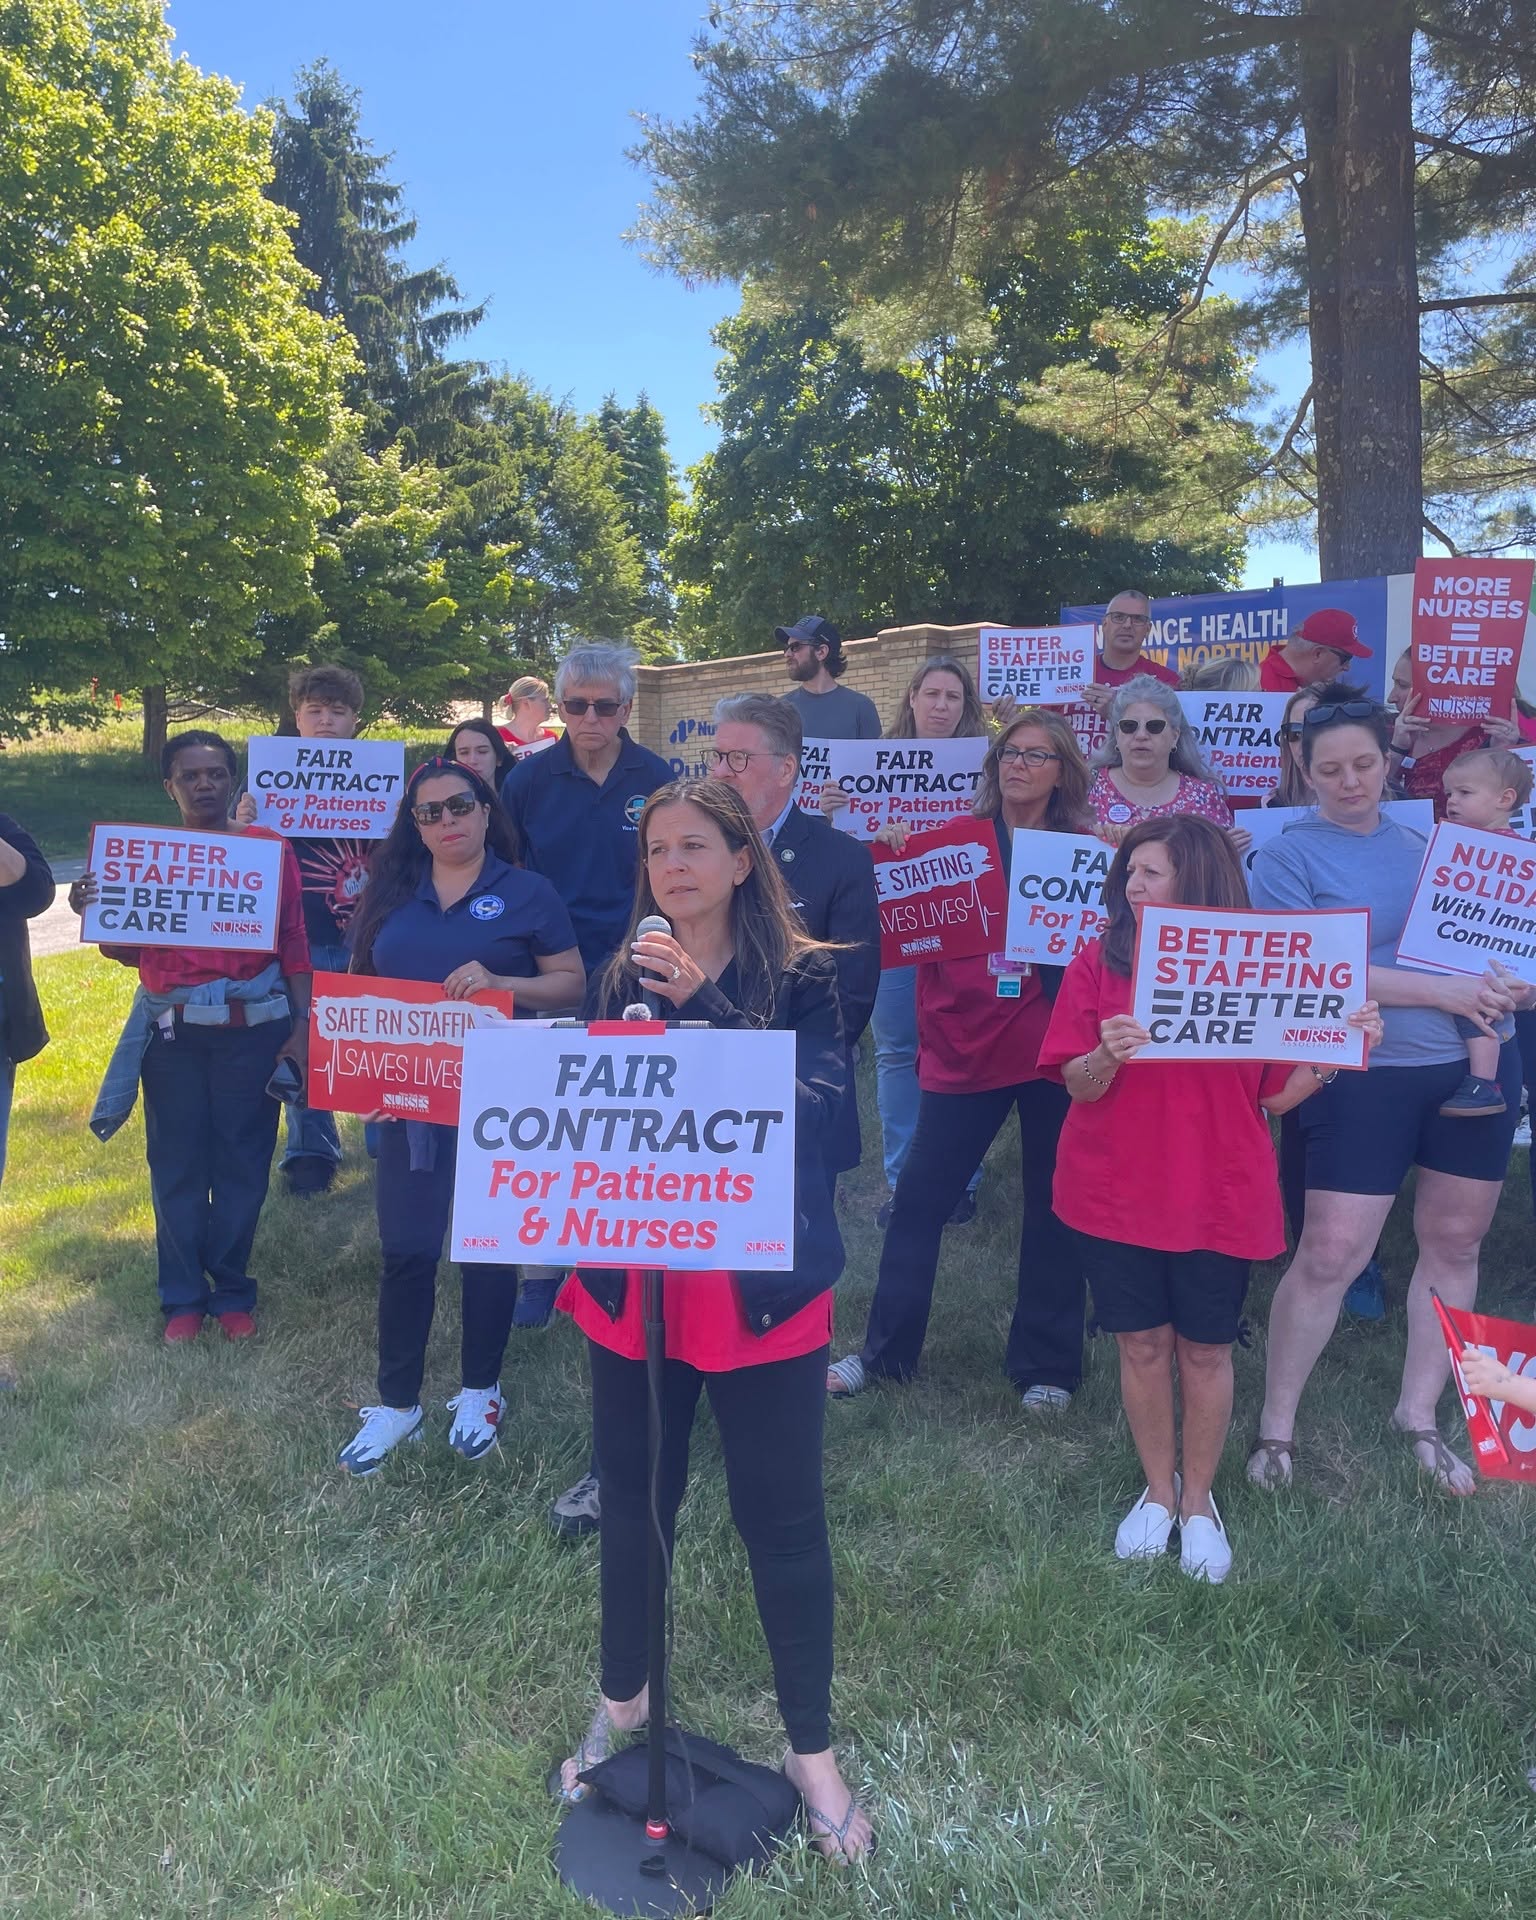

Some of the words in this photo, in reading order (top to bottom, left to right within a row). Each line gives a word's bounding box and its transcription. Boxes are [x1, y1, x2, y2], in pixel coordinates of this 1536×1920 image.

[1433, 576, 1512, 597] MORE
[1418, 598, 1525, 619] NURSES
[1201, 607, 1288, 642] HEALTH
[988, 636, 1062, 651] BETTER
[988, 649, 1085, 666] STAFFING
[1418, 644, 1514, 666] BETTER
[1426, 665, 1497, 686] CARE
[987, 683, 1041, 697] CARE
[1203, 702, 1264, 723] FAIR
[1429, 698, 1490, 713] NURSES
[295, 748, 353, 769] FAIR
[875, 750, 934, 770] FAIR
[255, 769, 399, 793] CONTRACT
[839, 771, 983, 794] CONTRACT
[1218, 771, 1279, 789] urses
[264, 792, 299, 810] For
[303, 794, 387, 813] Patients
[849, 796, 884, 814] For
[279, 812, 296, 830] &
[298, 813, 372, 831] Nurses
[865, 815, 881, 833] &
[104, 837, 227, 866] BETTER
[102, 860, 263, 891] STAFFING
[889, 851, 974, 892] STAFFING
[920, 896, 969, 929] LIVES
[1028, 904, 1074, 929] For
[1431, 892, 1487, 923] With
[99, 908, 188, 934] CARE
[210, 920, 263, 934] NURSES
[900, 937, 943, 954] NURSES
[1047, 932, 1067, 955] &
[1157, 924, 1313, 959] BETTER
[1154, 956, 1353, 990] STAFFING
[325, 1006, 369, 1033] SAFE
[376, 1009, 402, 1035] RN
[1150, 1019, 1256, 1045] CARE
[1282, 1028, 1347, 1044] NURSES
[344, 1048, 409, 1083] SAVES
[414, 1056, 463, 1090] LIVES
[554, 1054, 678, 1098] FAIR
[383, 1093, 429, 1109] NURSES
[472, 1106, 784, 1154] CONTRACT
[488, 1160, 561, 1199] For
[569, 1161, 755, 1203] Patients
[518, 1206, 550, 1247] &
[556, 1207, 719, 1250] Nurses
[462, 1237, 499, 1248] NURSES
[745, 1241, 786, 1252] NURSES
